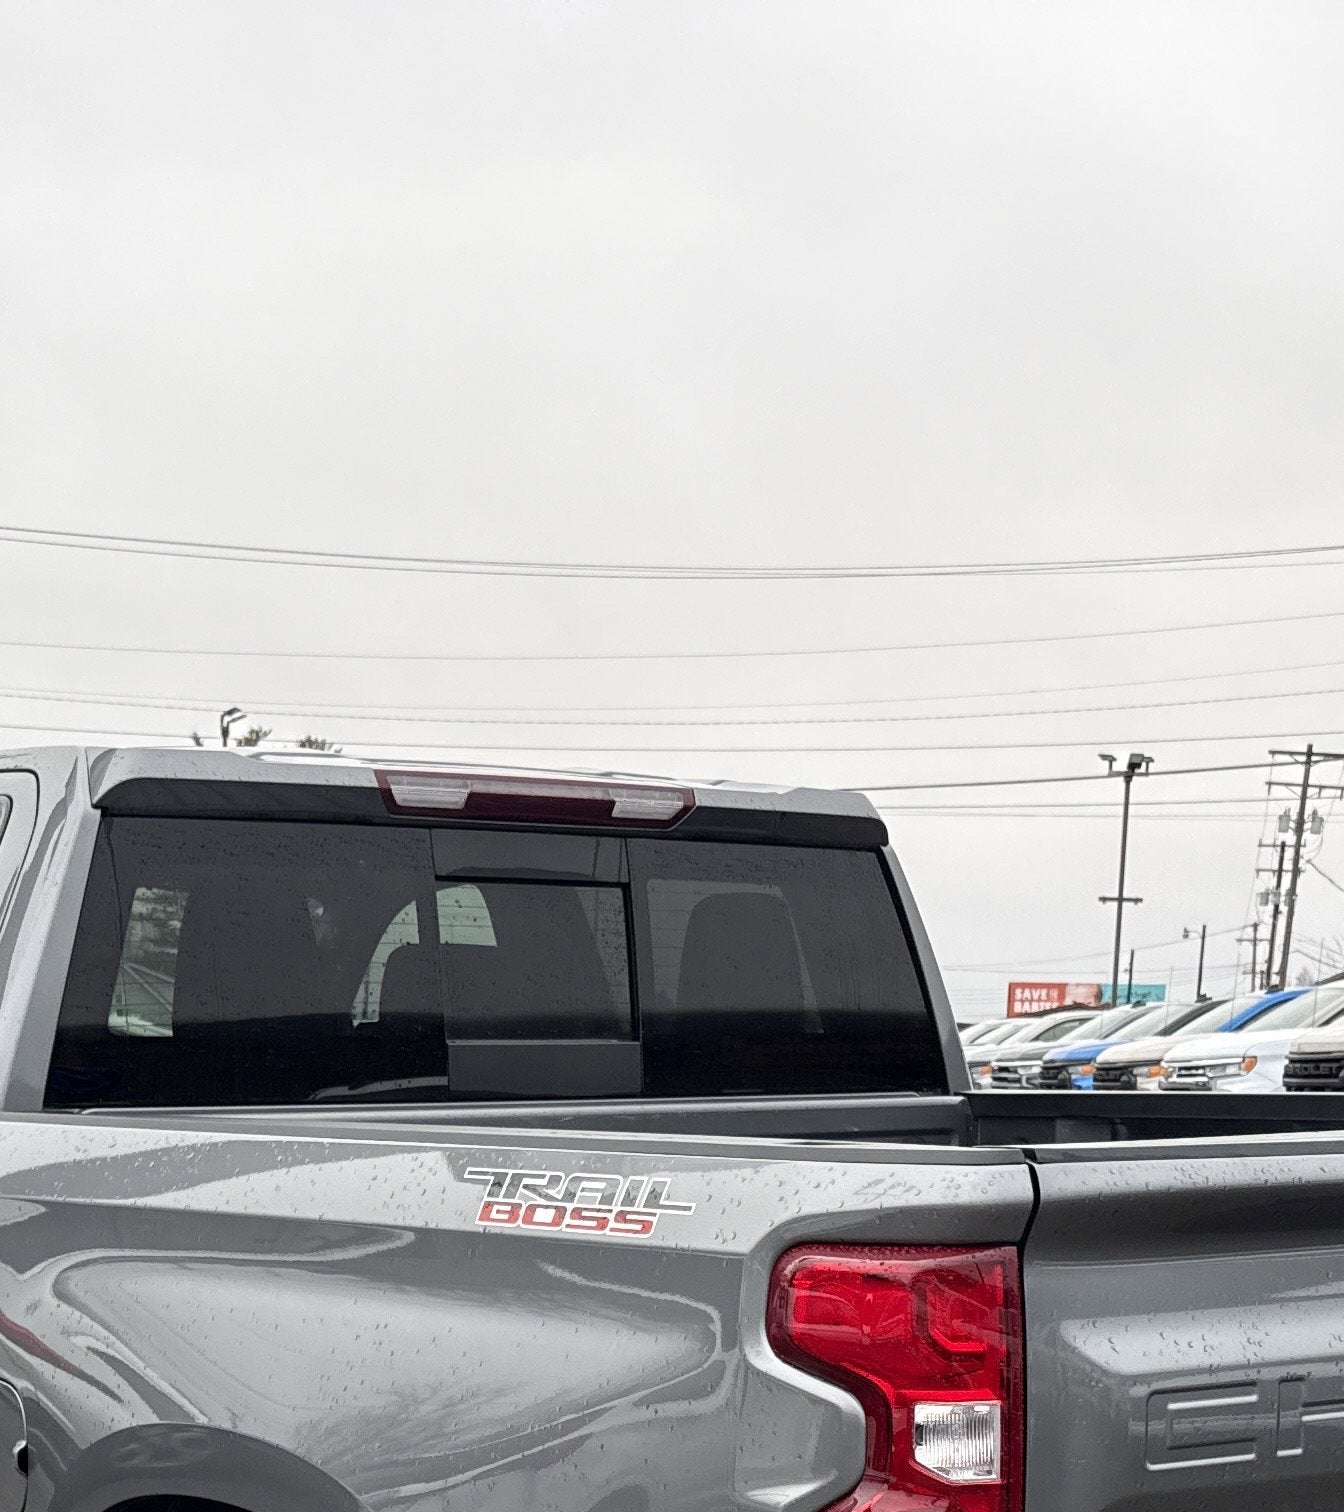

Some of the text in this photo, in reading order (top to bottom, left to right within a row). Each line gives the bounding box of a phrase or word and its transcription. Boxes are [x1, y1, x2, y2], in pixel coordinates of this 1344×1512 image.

[1014, 987, 1047, 1001] SAVE
[463, 1167, 697, 1216] TRAIL
[474, 1199, 659, 1239] BOSS
